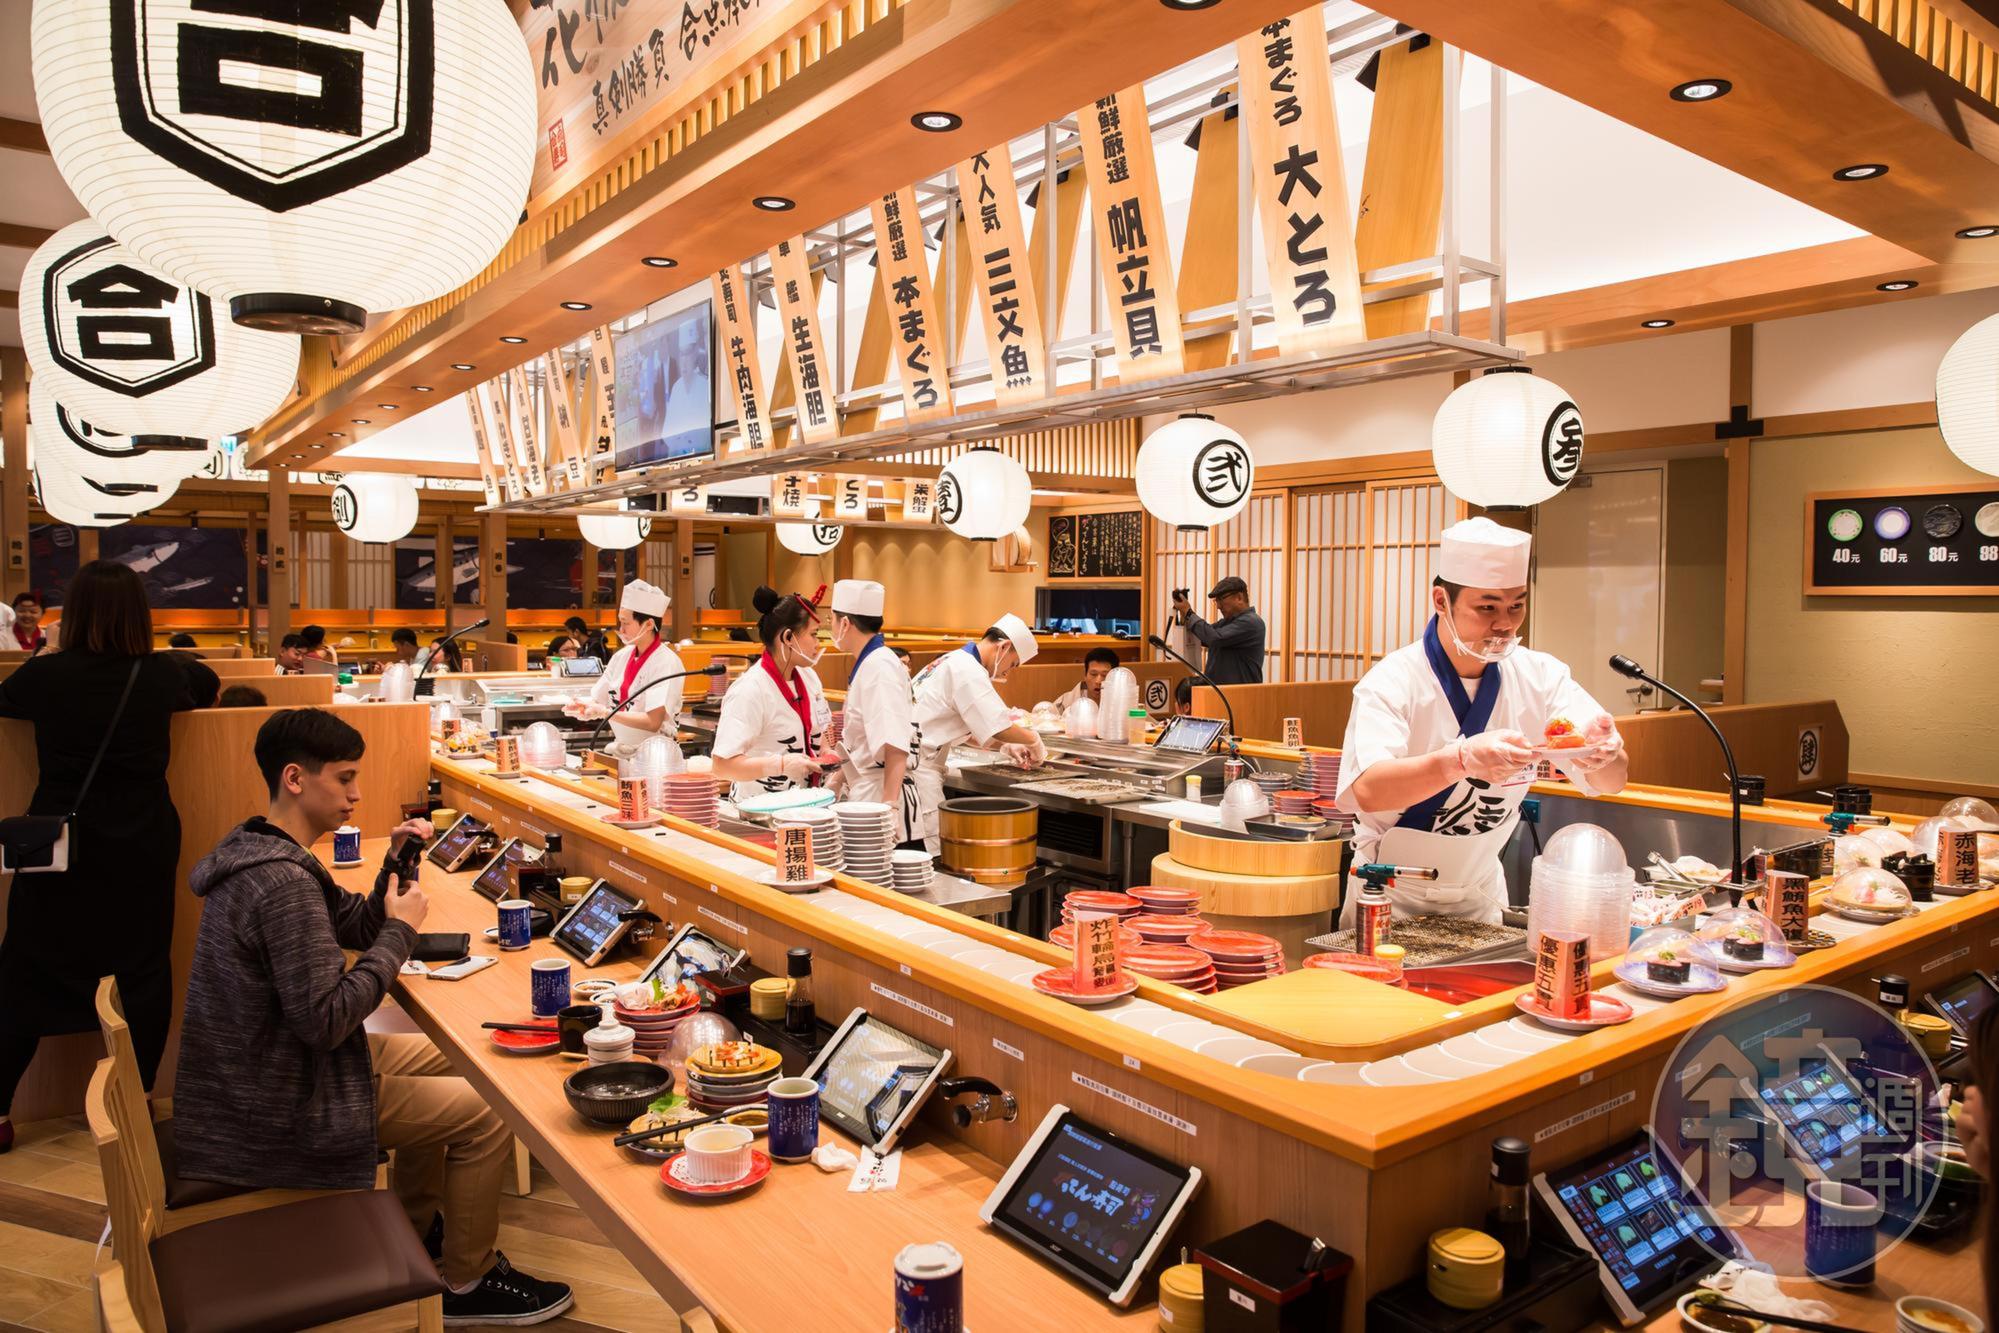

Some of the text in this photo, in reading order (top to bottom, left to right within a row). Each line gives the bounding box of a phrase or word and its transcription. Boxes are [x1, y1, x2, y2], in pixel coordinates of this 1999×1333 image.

[1273, 144, 1337, 327] 大とろ
[67, 264, 179, 361] 合
[1106, 197, 1164, 360] 帆立貝
[892, 275, 938, 410] 本まぐろ
[984, 247, 1033, 390] 三文魚
[1832, 548, 1861, 563] 40元
[1879, 547, 1908, 563] 60元
[1928, 546, 1959, 563] 80元
[784, 829, 808, 882] 唐揚雞
[1955, 833, 1976, 884] 赤海老
